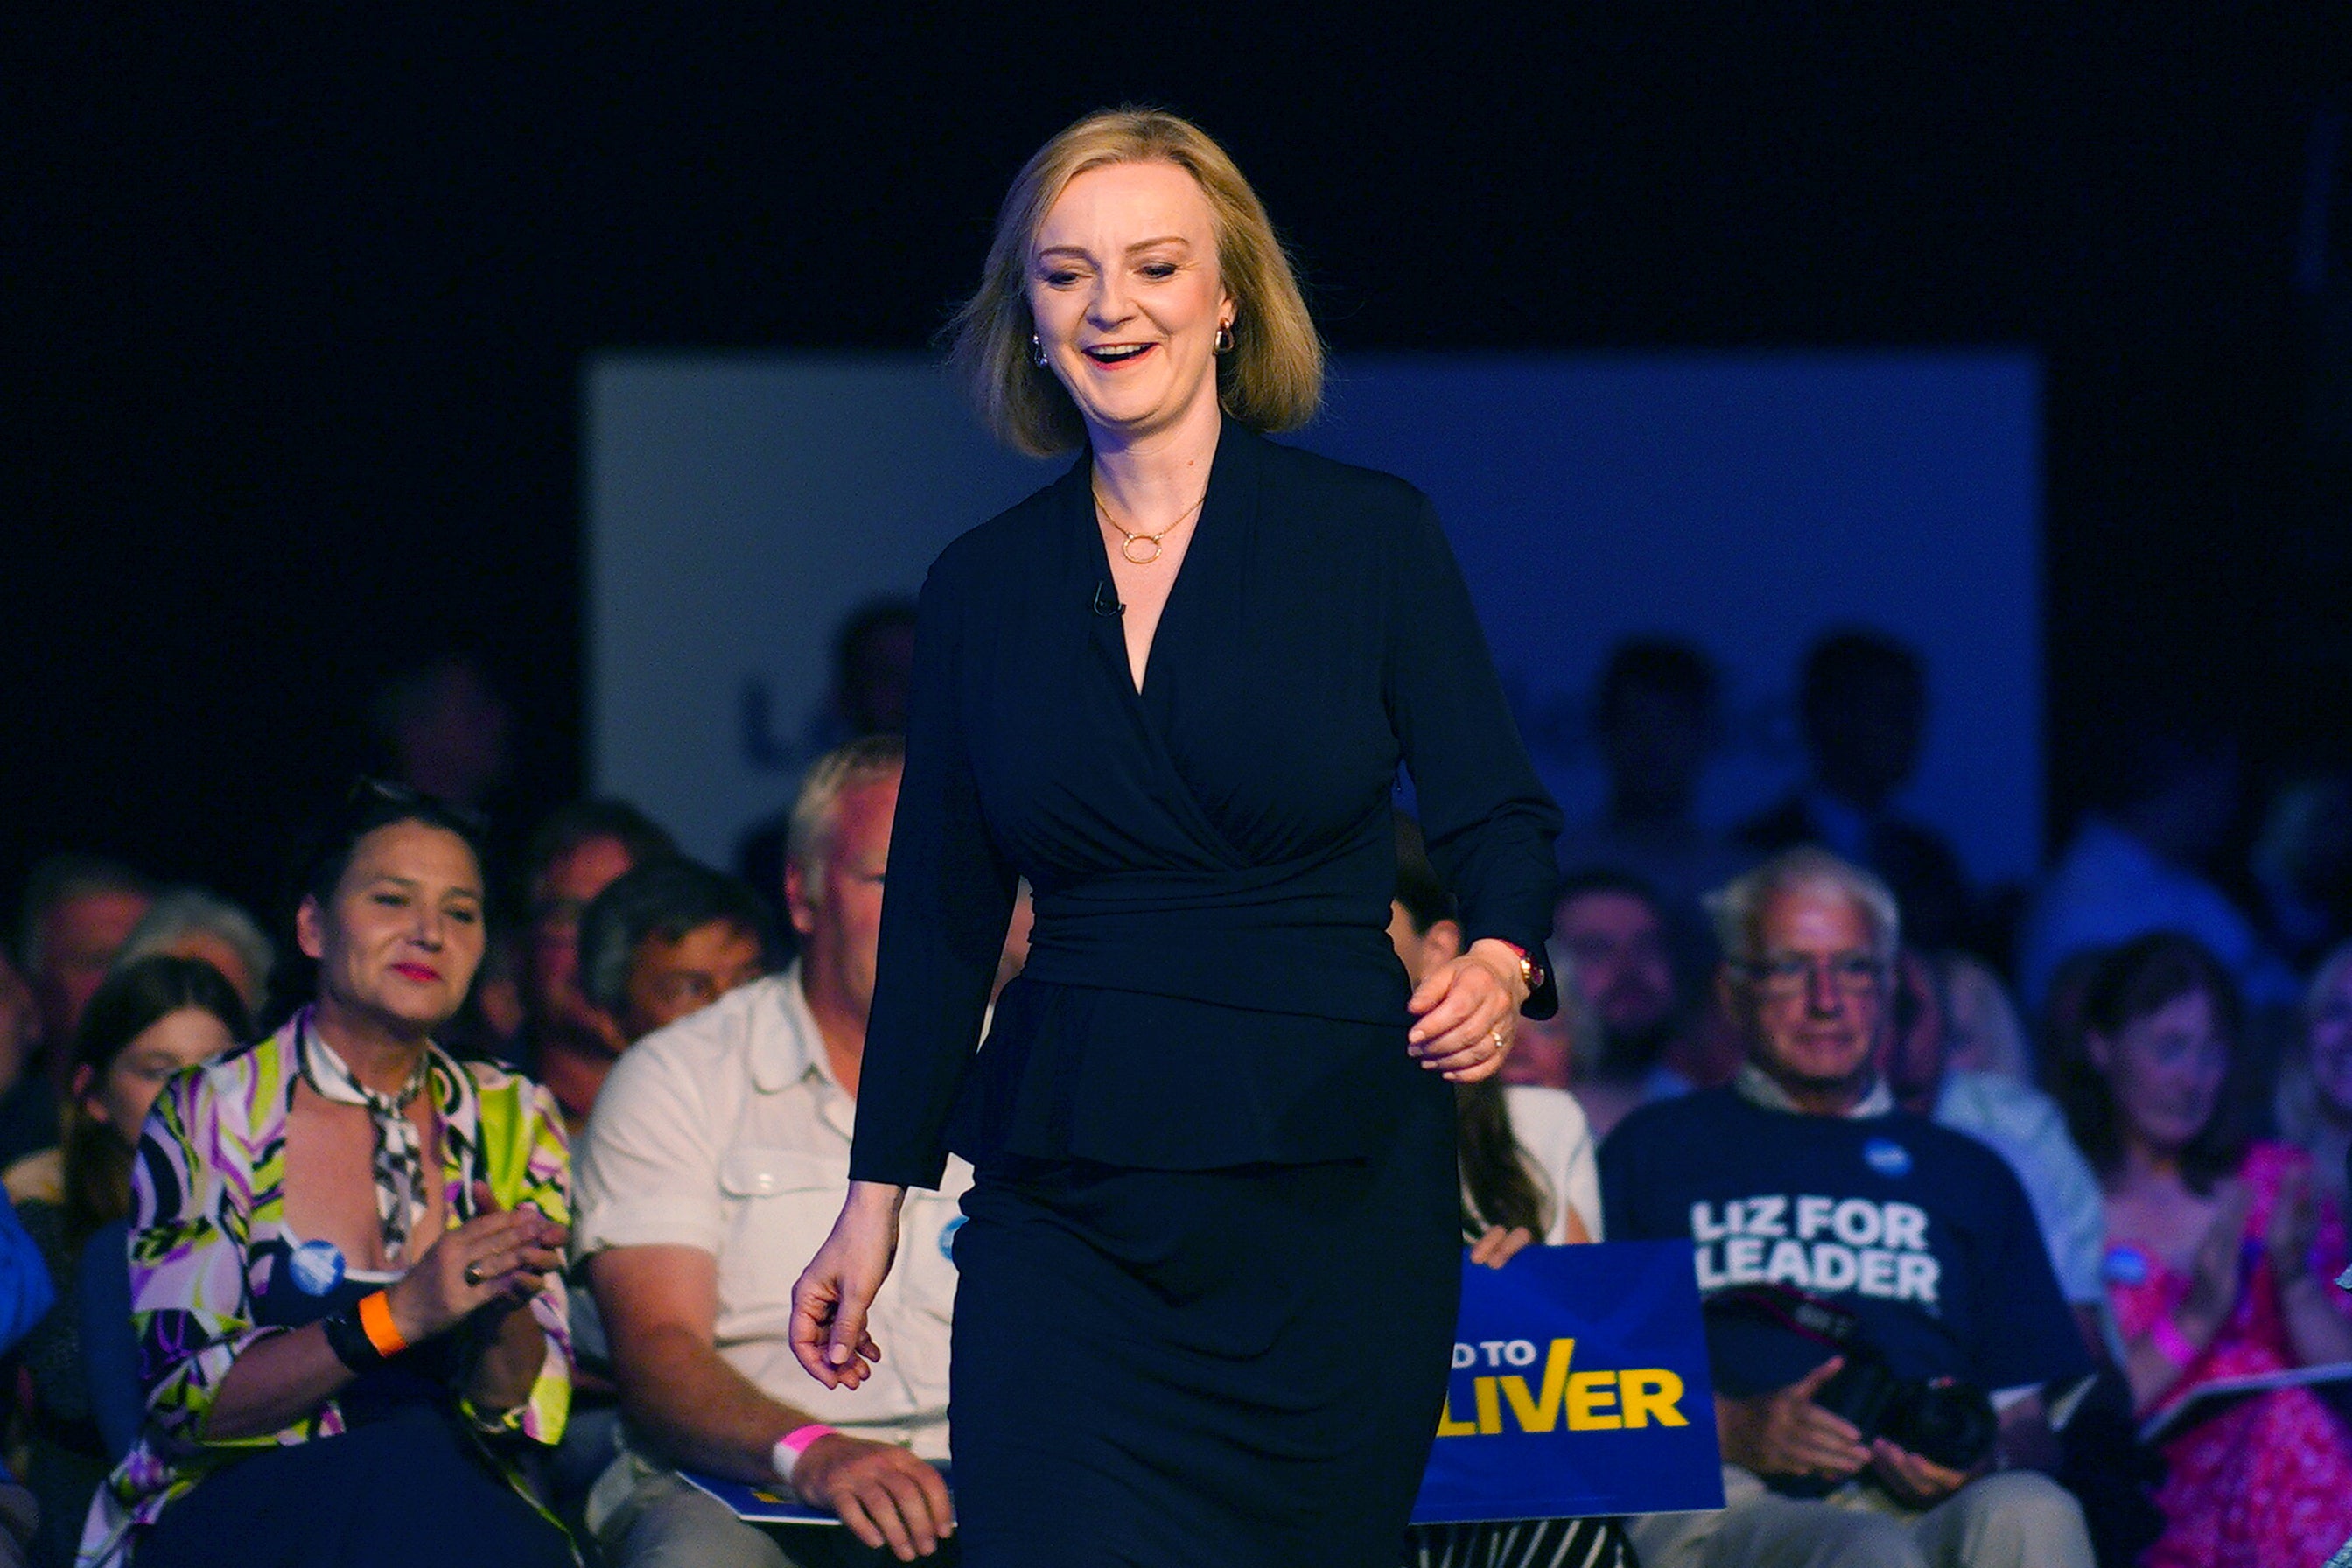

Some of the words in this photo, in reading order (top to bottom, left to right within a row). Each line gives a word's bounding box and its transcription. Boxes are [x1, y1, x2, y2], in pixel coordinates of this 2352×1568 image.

[1690, 1195, 1786, 1240] LIZ
[1796, 1195, 1928, 1250] FOR
[1695, 1239, 1941, 1302] LEADER
[1480, 1340, 1536, 1367] TO
